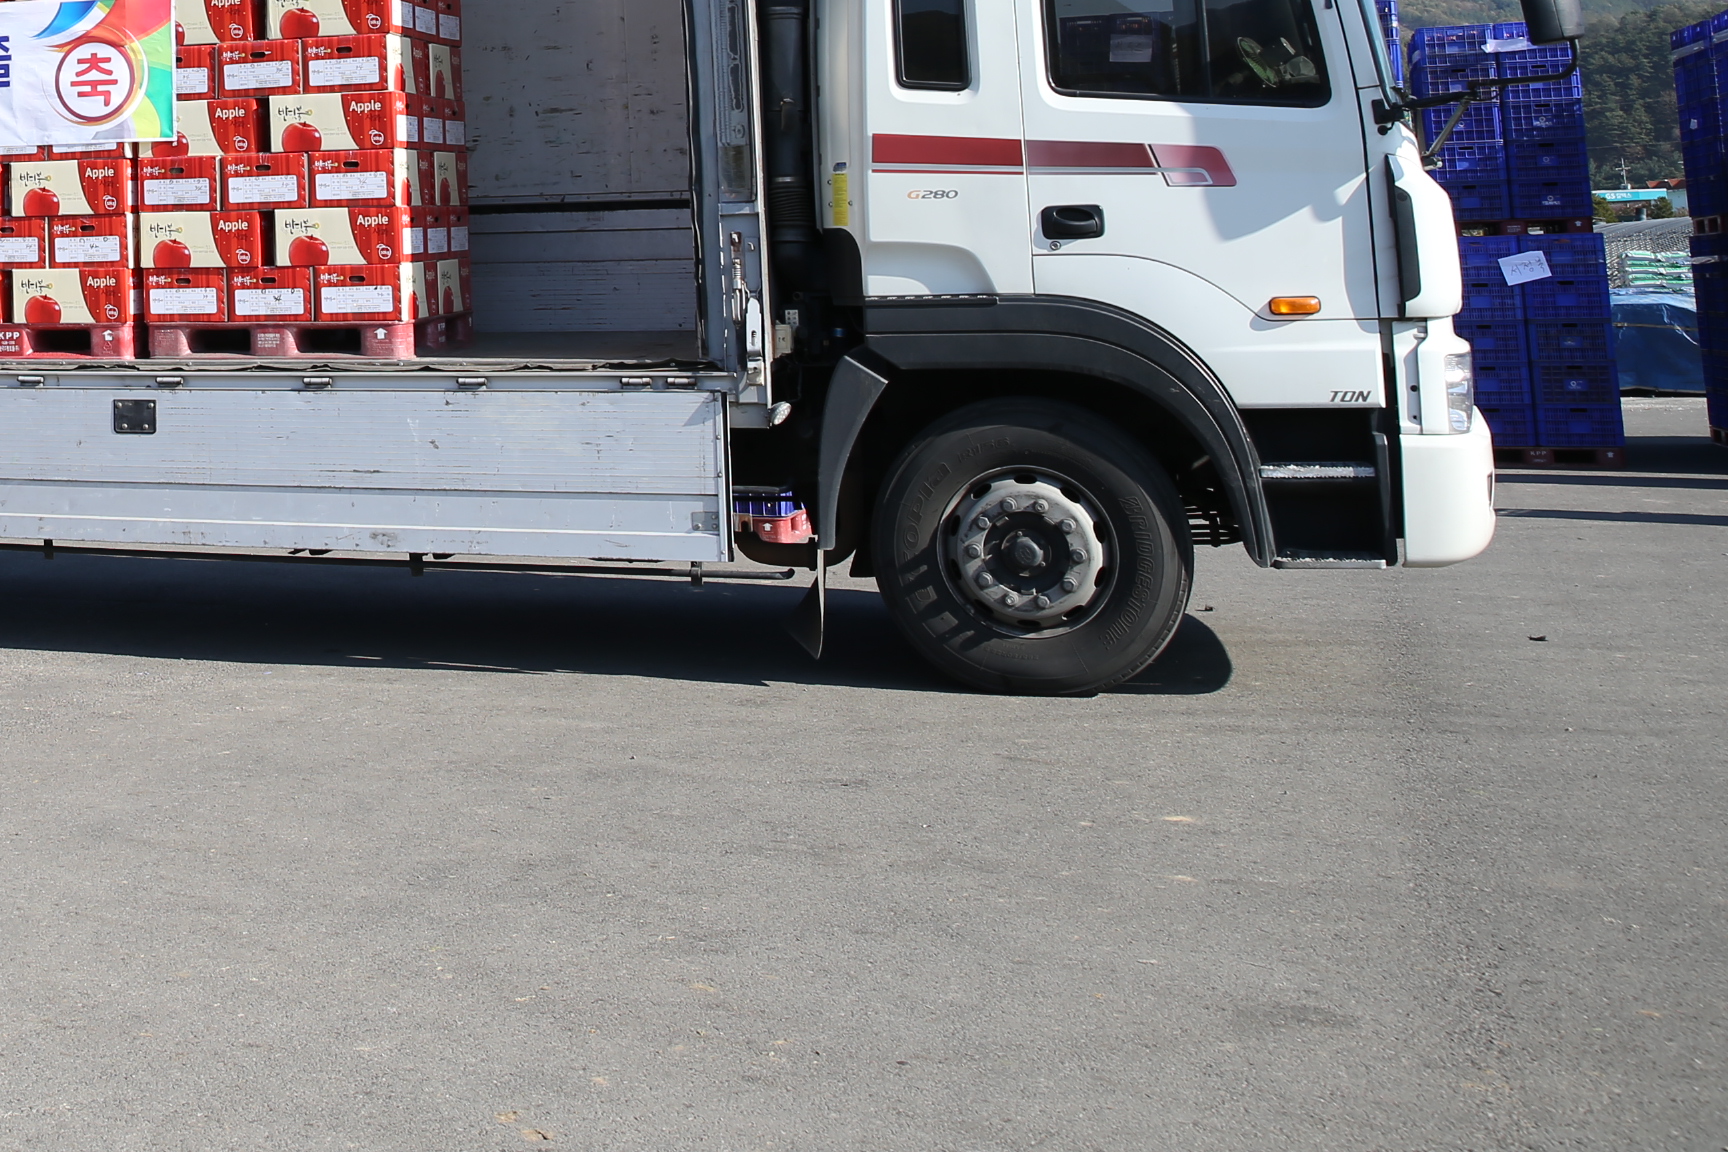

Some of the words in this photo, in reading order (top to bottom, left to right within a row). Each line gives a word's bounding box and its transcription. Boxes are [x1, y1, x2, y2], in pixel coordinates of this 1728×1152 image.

[70, 52, 118, 107] 축
[214, 106, 245, 119] Apple
[349, 100, 381, 113] Apple
[85, 166, 115, 179] Apple
[907, 190, 959, 199] G280
[217, 219, 249, 232] Apple
[356, 214, 389, 228] Apple
[87, 276, 116, 288] Apple
[1329, 390, 1372, 403] TON
